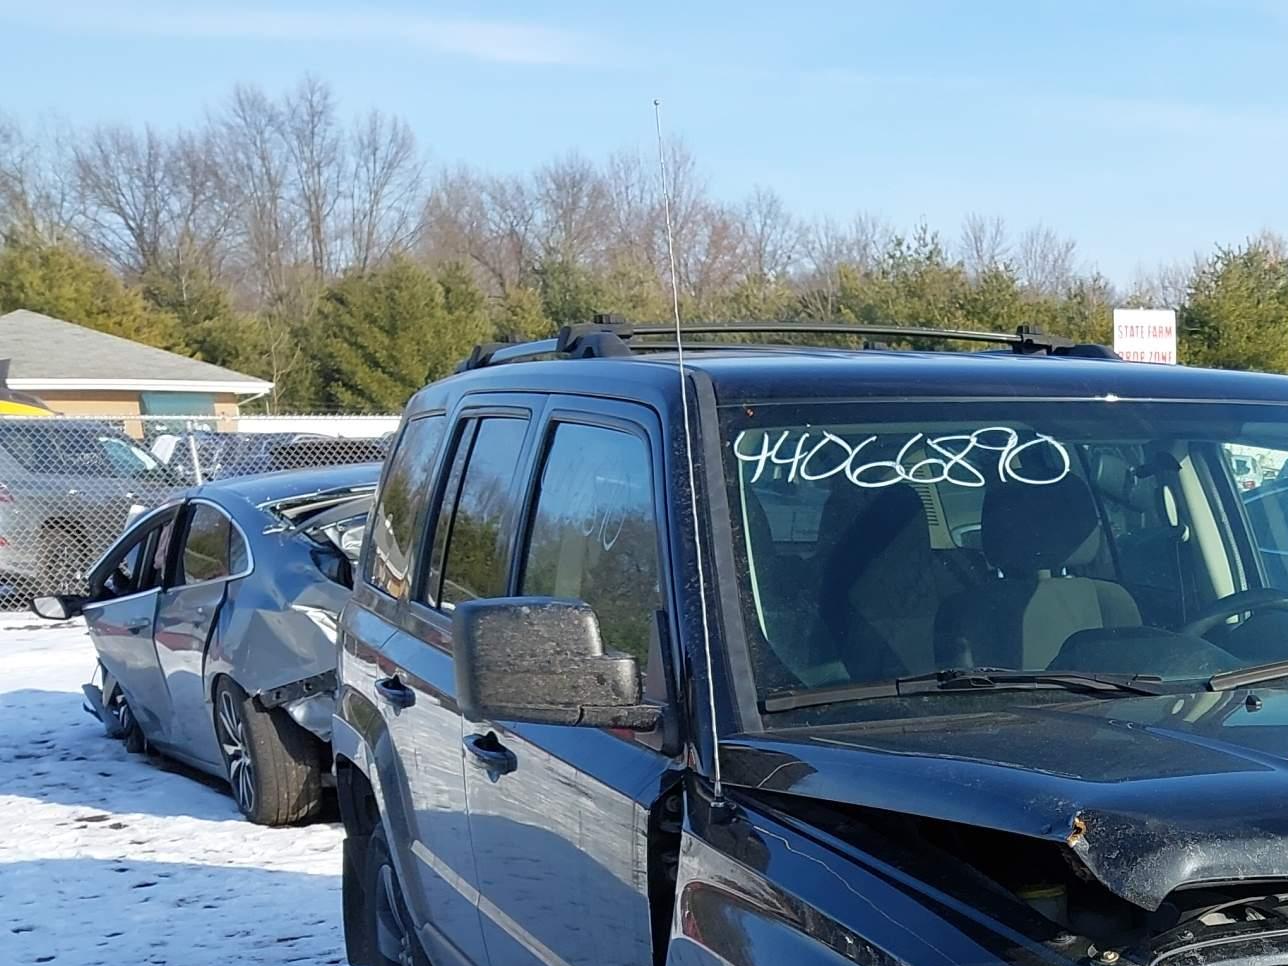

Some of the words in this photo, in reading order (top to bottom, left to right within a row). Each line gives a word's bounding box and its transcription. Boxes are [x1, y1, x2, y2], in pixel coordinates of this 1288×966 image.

[1118, 325, 1145, 339] STATE
[1148, 325, 1173, 339] FARM
[734, 426, 1070, 488] 44066890
